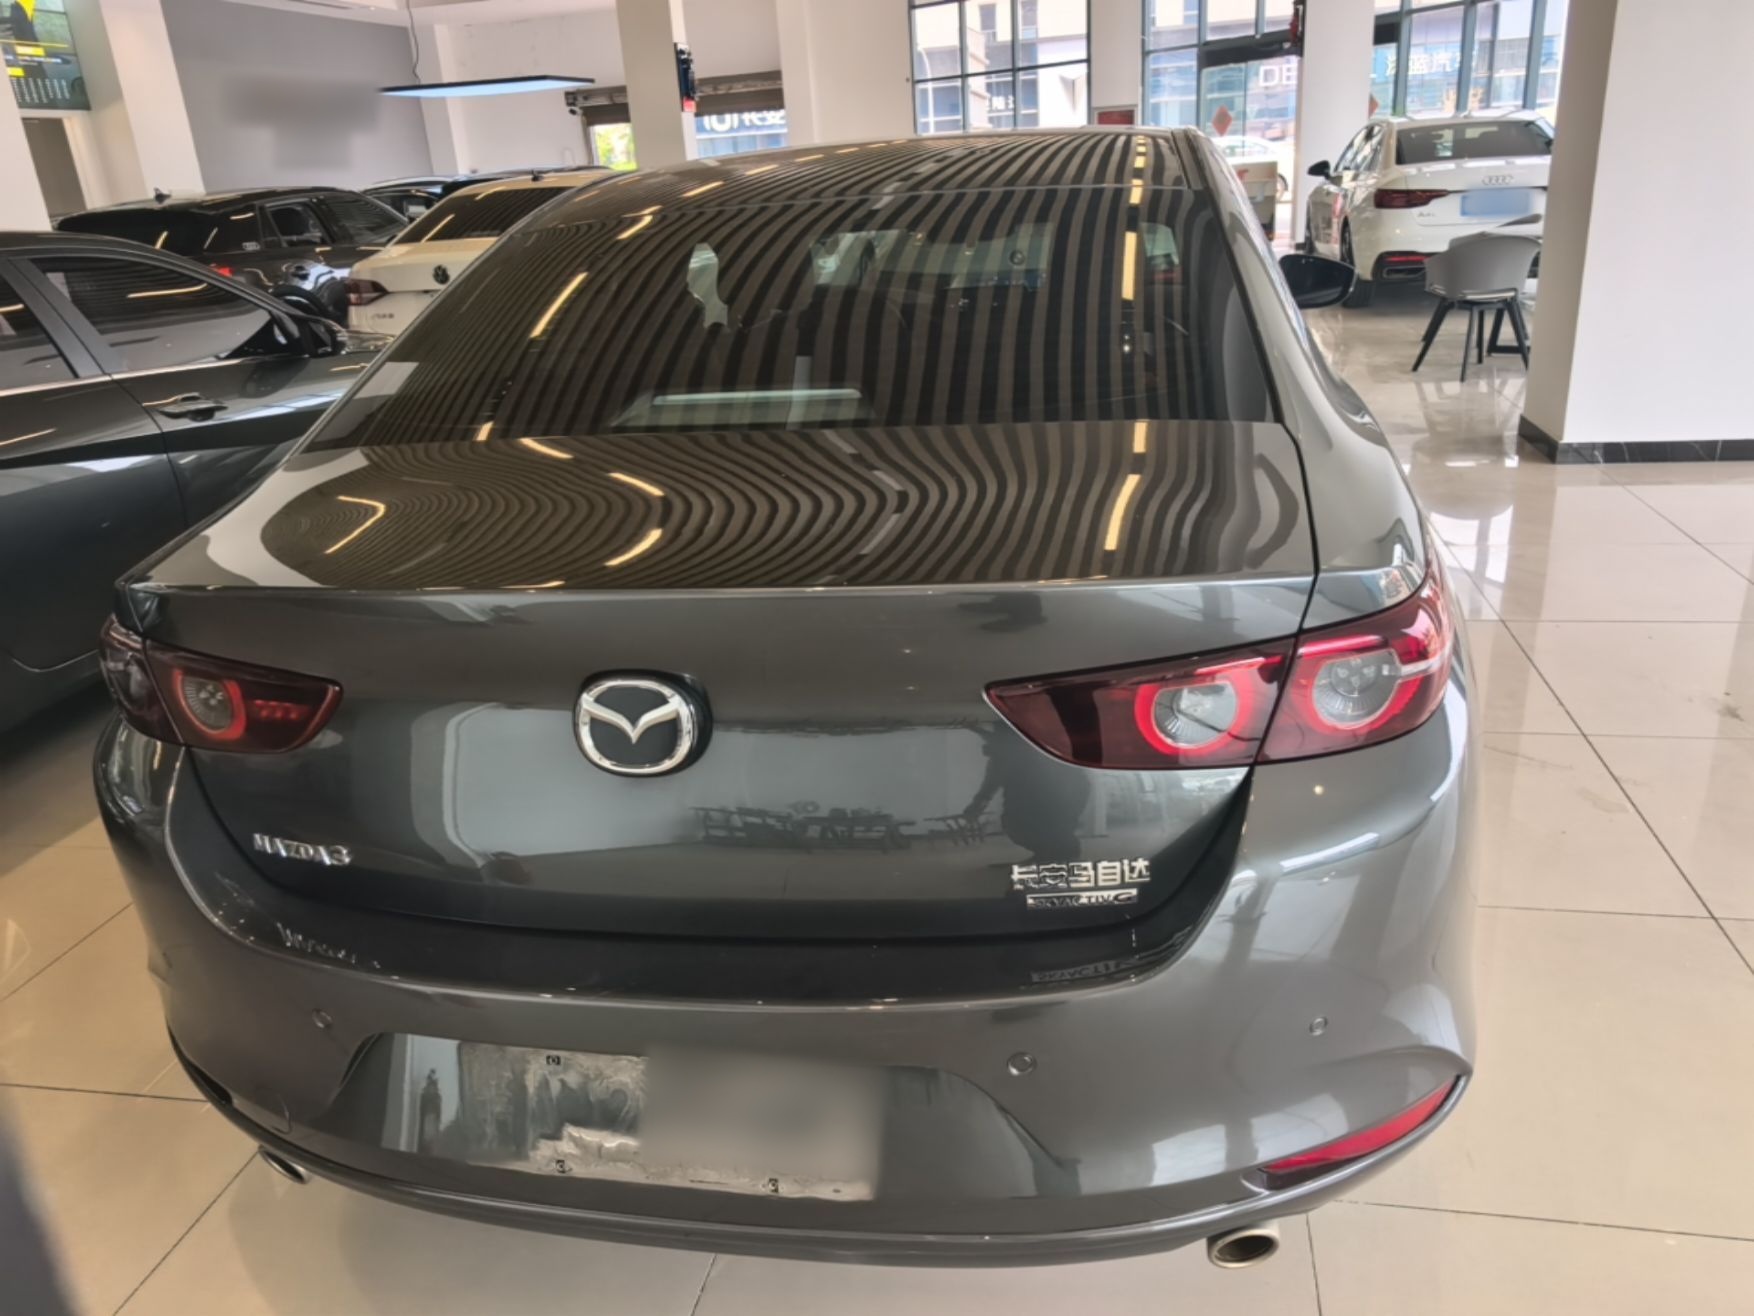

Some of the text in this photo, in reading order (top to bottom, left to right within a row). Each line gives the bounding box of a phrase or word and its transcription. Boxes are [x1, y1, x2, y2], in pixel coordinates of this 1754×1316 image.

[1011, 857, 1151, 889] 长安马自达
